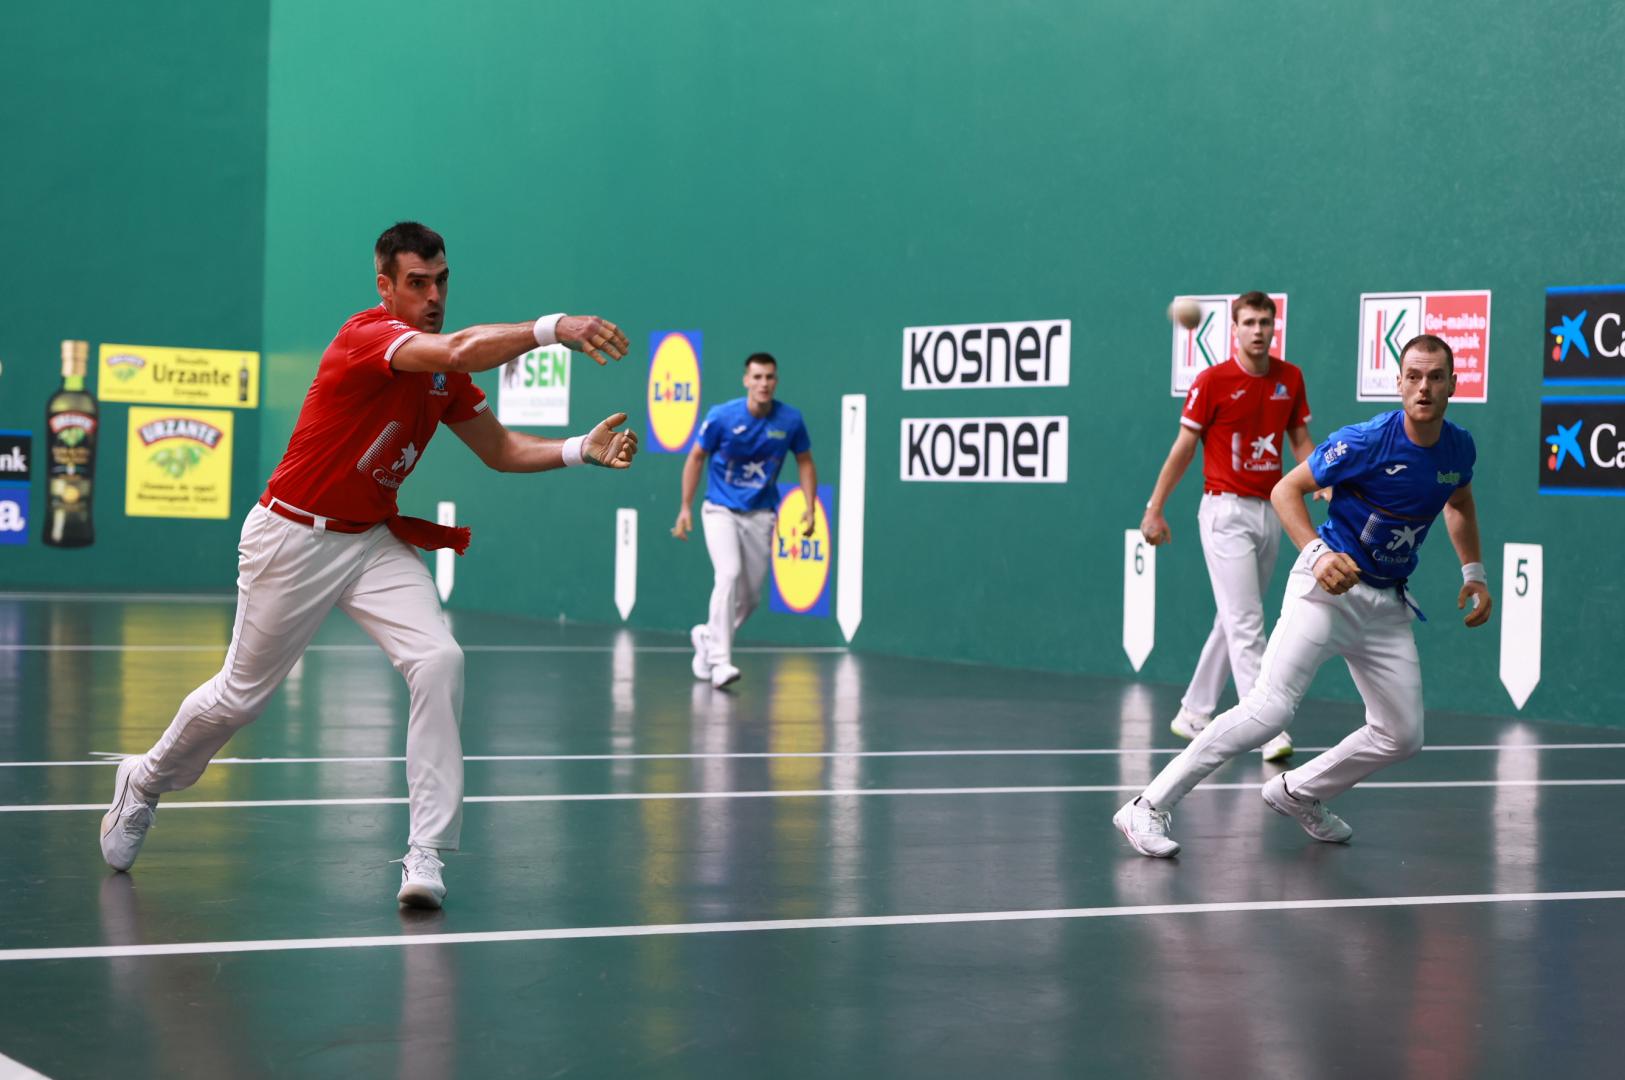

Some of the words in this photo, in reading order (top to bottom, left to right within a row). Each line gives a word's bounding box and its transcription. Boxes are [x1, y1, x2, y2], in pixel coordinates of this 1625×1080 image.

[153, 363, 231, 387] Urzante
[524, 351, 566, 388] SEN
[141, 419, 219, 447] URZANTE
[1135, 542, 1144, 575] 6
[1515, 558, 1528, 597] 5
